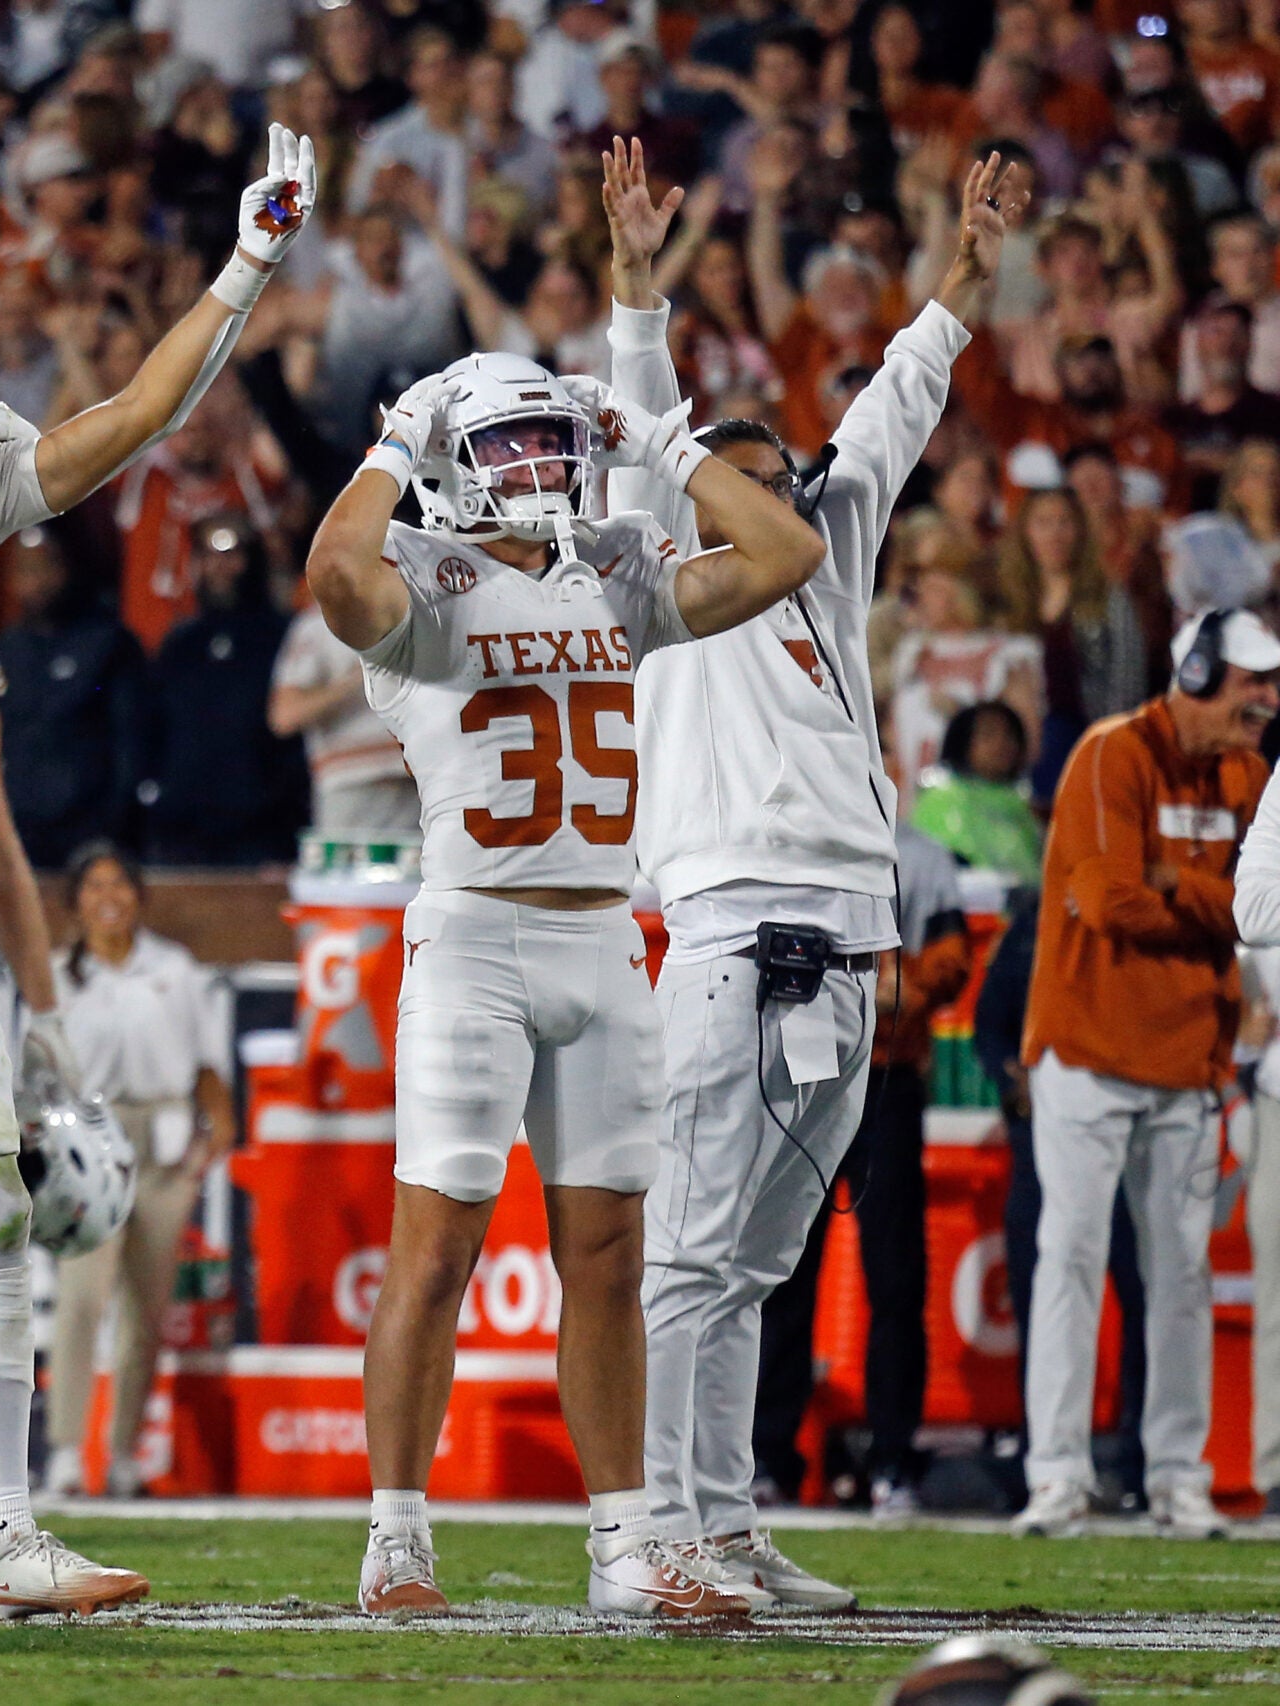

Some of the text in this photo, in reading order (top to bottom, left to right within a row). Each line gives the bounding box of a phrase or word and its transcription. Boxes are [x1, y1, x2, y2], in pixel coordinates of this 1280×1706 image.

[437, 557, 476, 593] SEC
[467, 626, 634, 679] TEXAS
[460, 681, 638, 848] 35
[304, 931, 361, 1008] G
